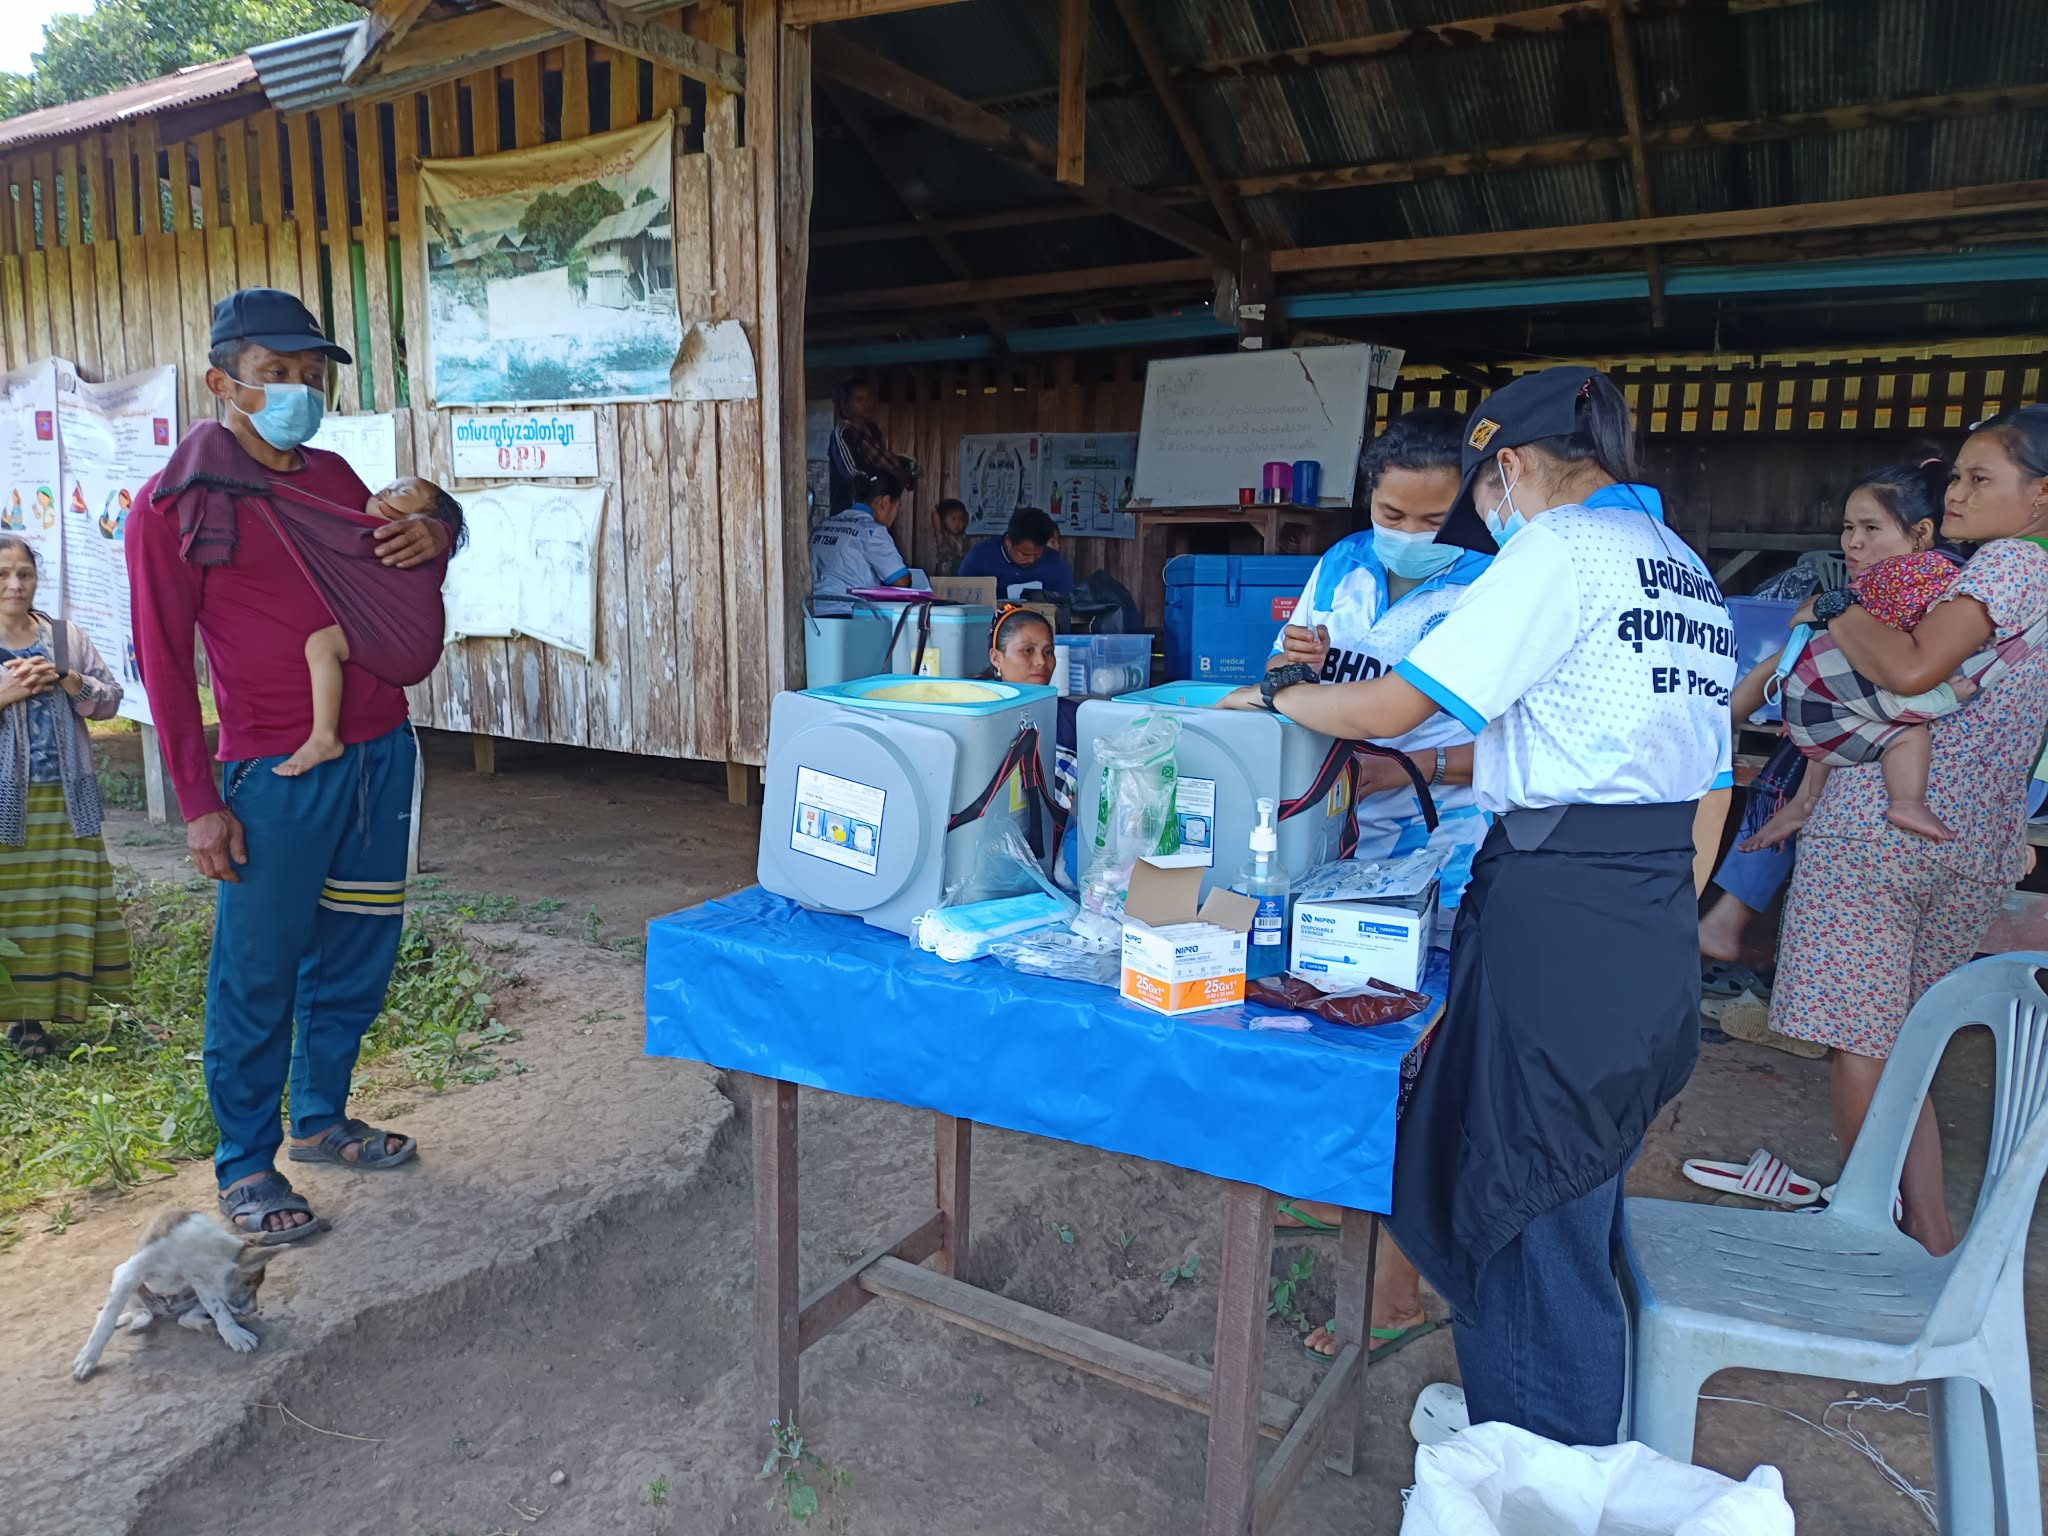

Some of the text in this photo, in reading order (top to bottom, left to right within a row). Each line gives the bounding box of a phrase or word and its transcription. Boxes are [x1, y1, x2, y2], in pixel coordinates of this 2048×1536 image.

[1320, 648, 1393, 684] BHD
[1314, 916, 1336, 924] NIPRO
[1300, 925, 1334, 934] DISPOSABLE
[1125, 933, 1142, 944] NIPRO
[1175, 945, 1199, 955] NIPRO
